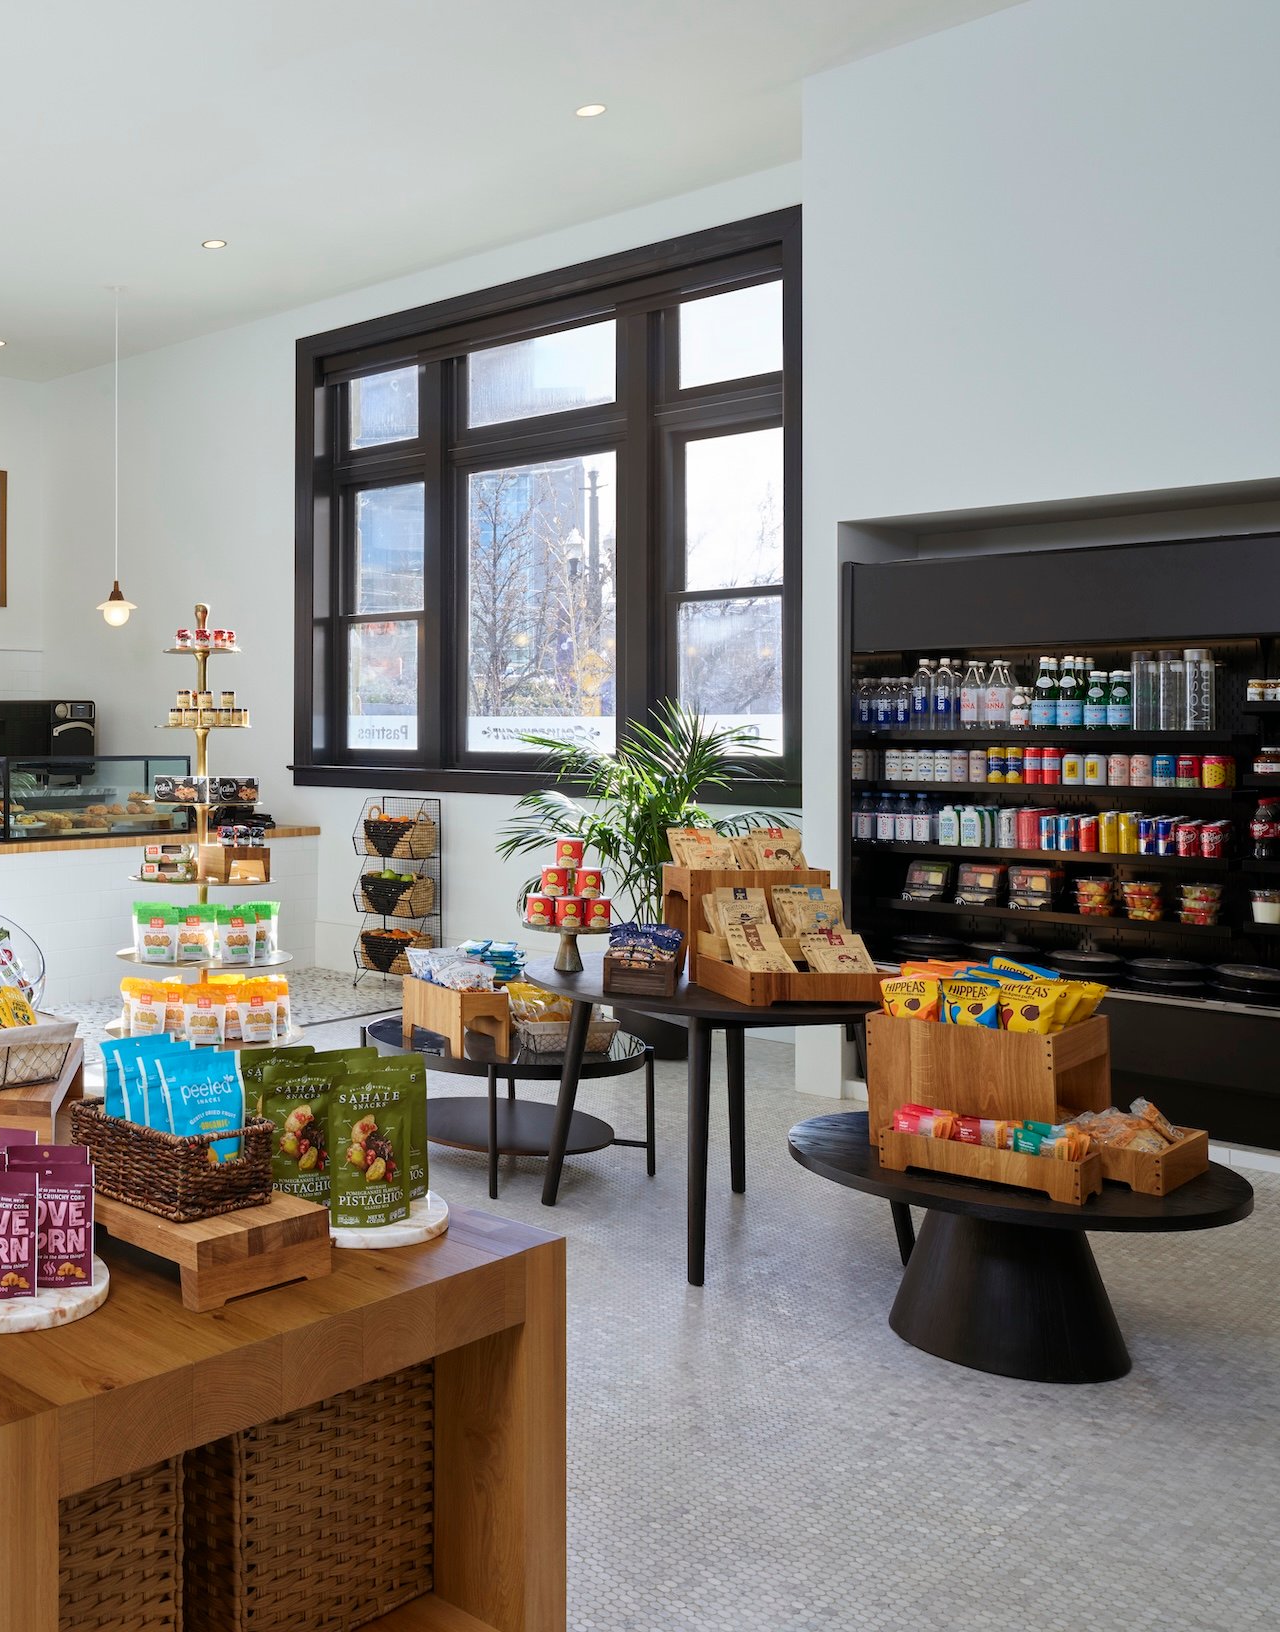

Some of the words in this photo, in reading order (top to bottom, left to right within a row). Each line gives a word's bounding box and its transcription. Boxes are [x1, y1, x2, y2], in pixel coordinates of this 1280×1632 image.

[914, 686, 922, 711] smart
[937, 685, 945, 711] smart
[897, 698, 905, 721] smart
[885, 981, 926, 993] HIPPEAS
[948, 984, 989, 998] HIPPEAS
[1000, 983, 1048, 998] HIPPEAS
[180, 1077, 232, 1106] peeled
[339, 1091, 400, 1104] SAHALE
[196, 1097, 221, 1105] SNACKS
[353, 1102, 386, 1110] SNACKS
[338, 1189, 404, 1206] PISTACHIOS
[13, 1202, 30, 1210] CORN
